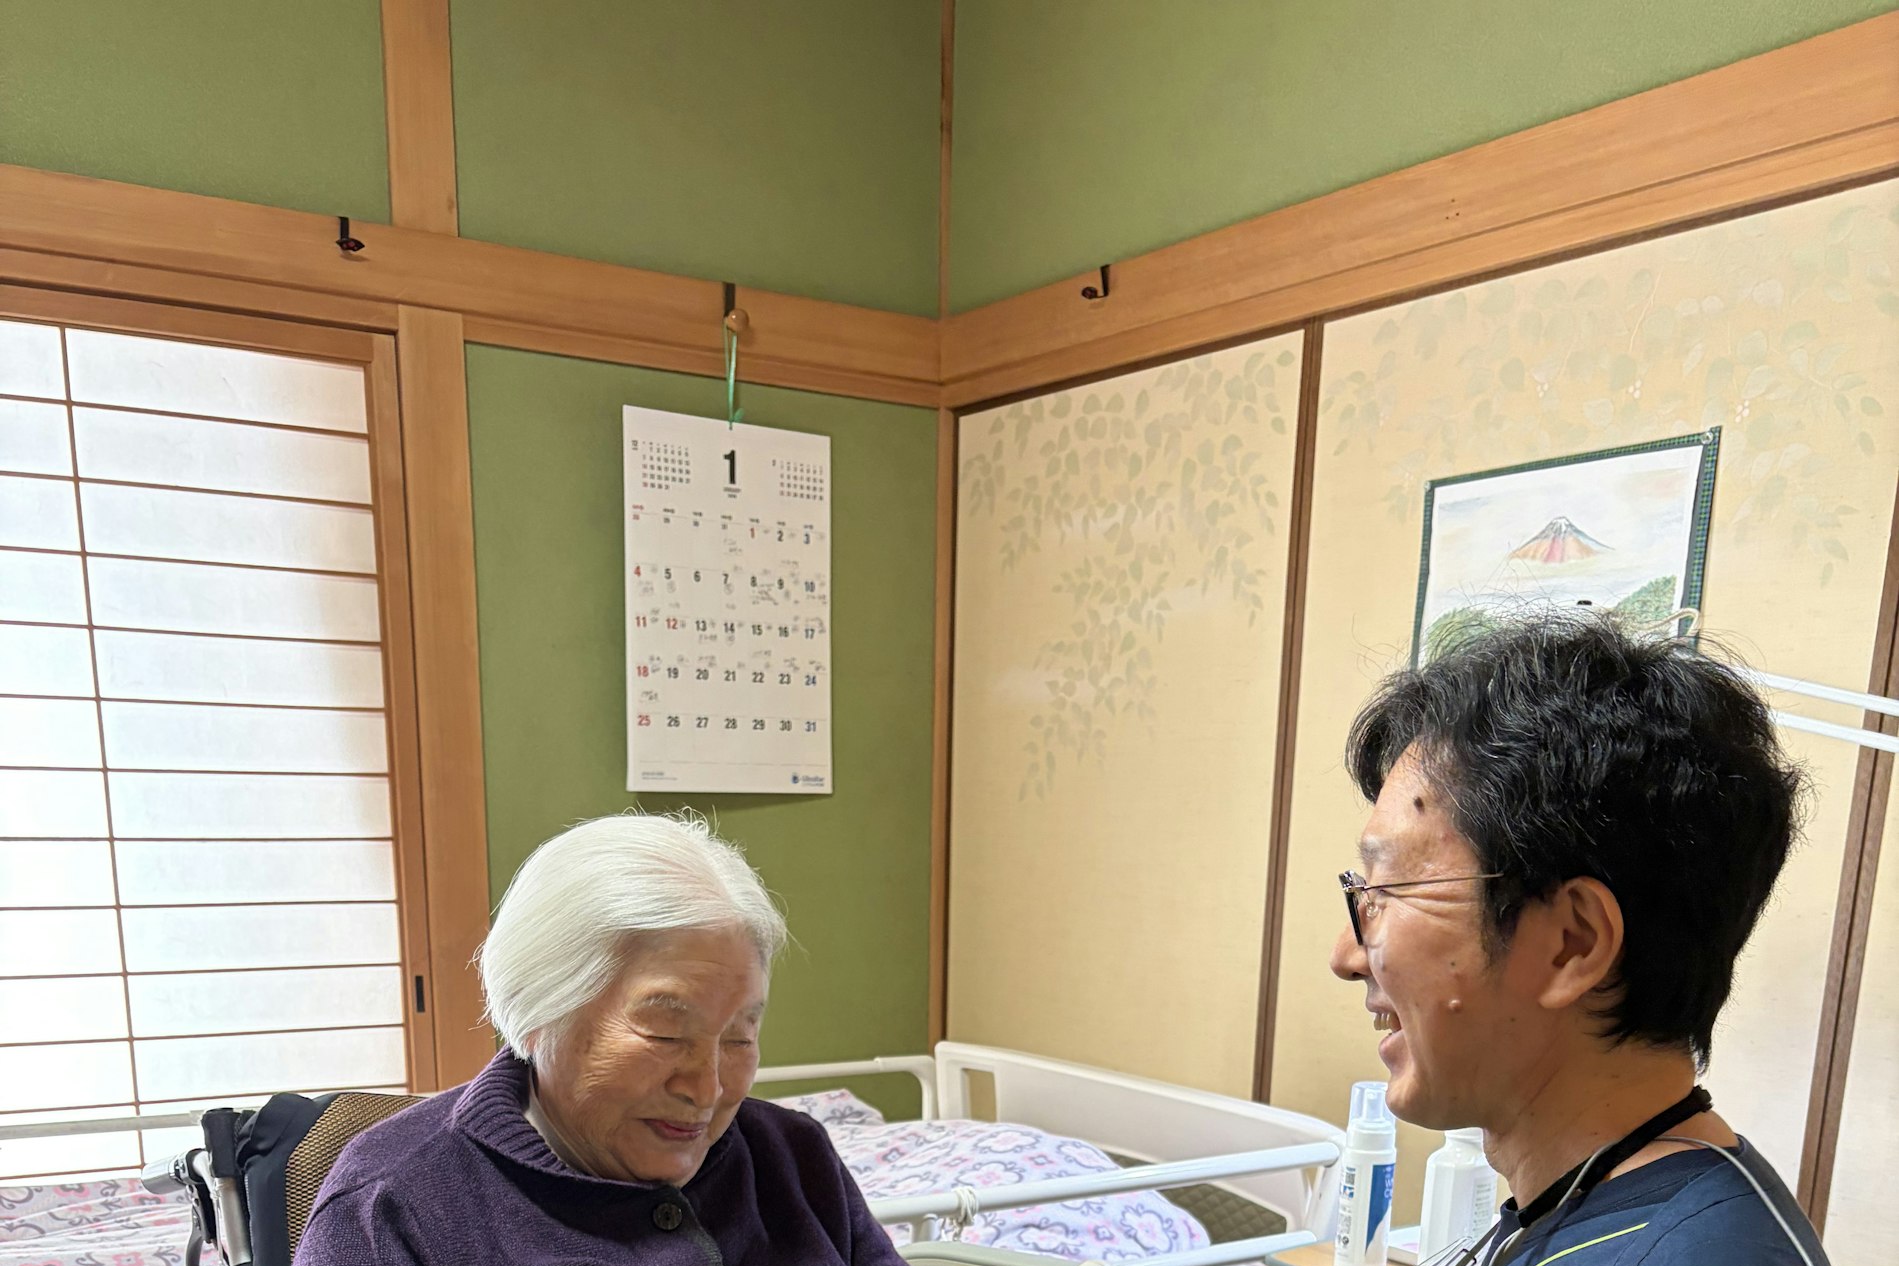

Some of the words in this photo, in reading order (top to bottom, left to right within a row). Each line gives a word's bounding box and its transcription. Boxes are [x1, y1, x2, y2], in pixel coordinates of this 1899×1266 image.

[723, 449, 736, 485] 1
[749, 527, 756, 538] 1
[777, 530, 784, 542] 2
[803, 533, 811, 544] 3
[633, 566, 642, 576] 4
[664, 568, 672, 579] 5
[693, 571, 702, 582] 6
[722, 573, 730, 584] 7
[635, 616, 647, 627] 11
[665, 618, 677, 629] 12
[695, 620, 707, 632] 13
[723, 623, 735, 633] 14
[751, 624, 762, 635] 15
[777, 626, 789, 637] 16
[804, 628, 815, 639] 17
[636, 666, 649, 677] 18
[666, 667, 679, 679] 19
[695, 669, 709, 680] 20
[723, 670, 736, 681] 21
[751, 672, 764, 683] 22
[778, 673, 791, 684] 23
[804, 675, 816, 686] 24
[637, 715, 651, 726] 25
[666, 716, 680, 727] 26
[695, 717, 709, 728] 27
[724, 718, 737, 729] 28
[752, 719, 765, 730] 29
[779, 720, 792, 731] 30
[805, 721, 816, 732] 31
